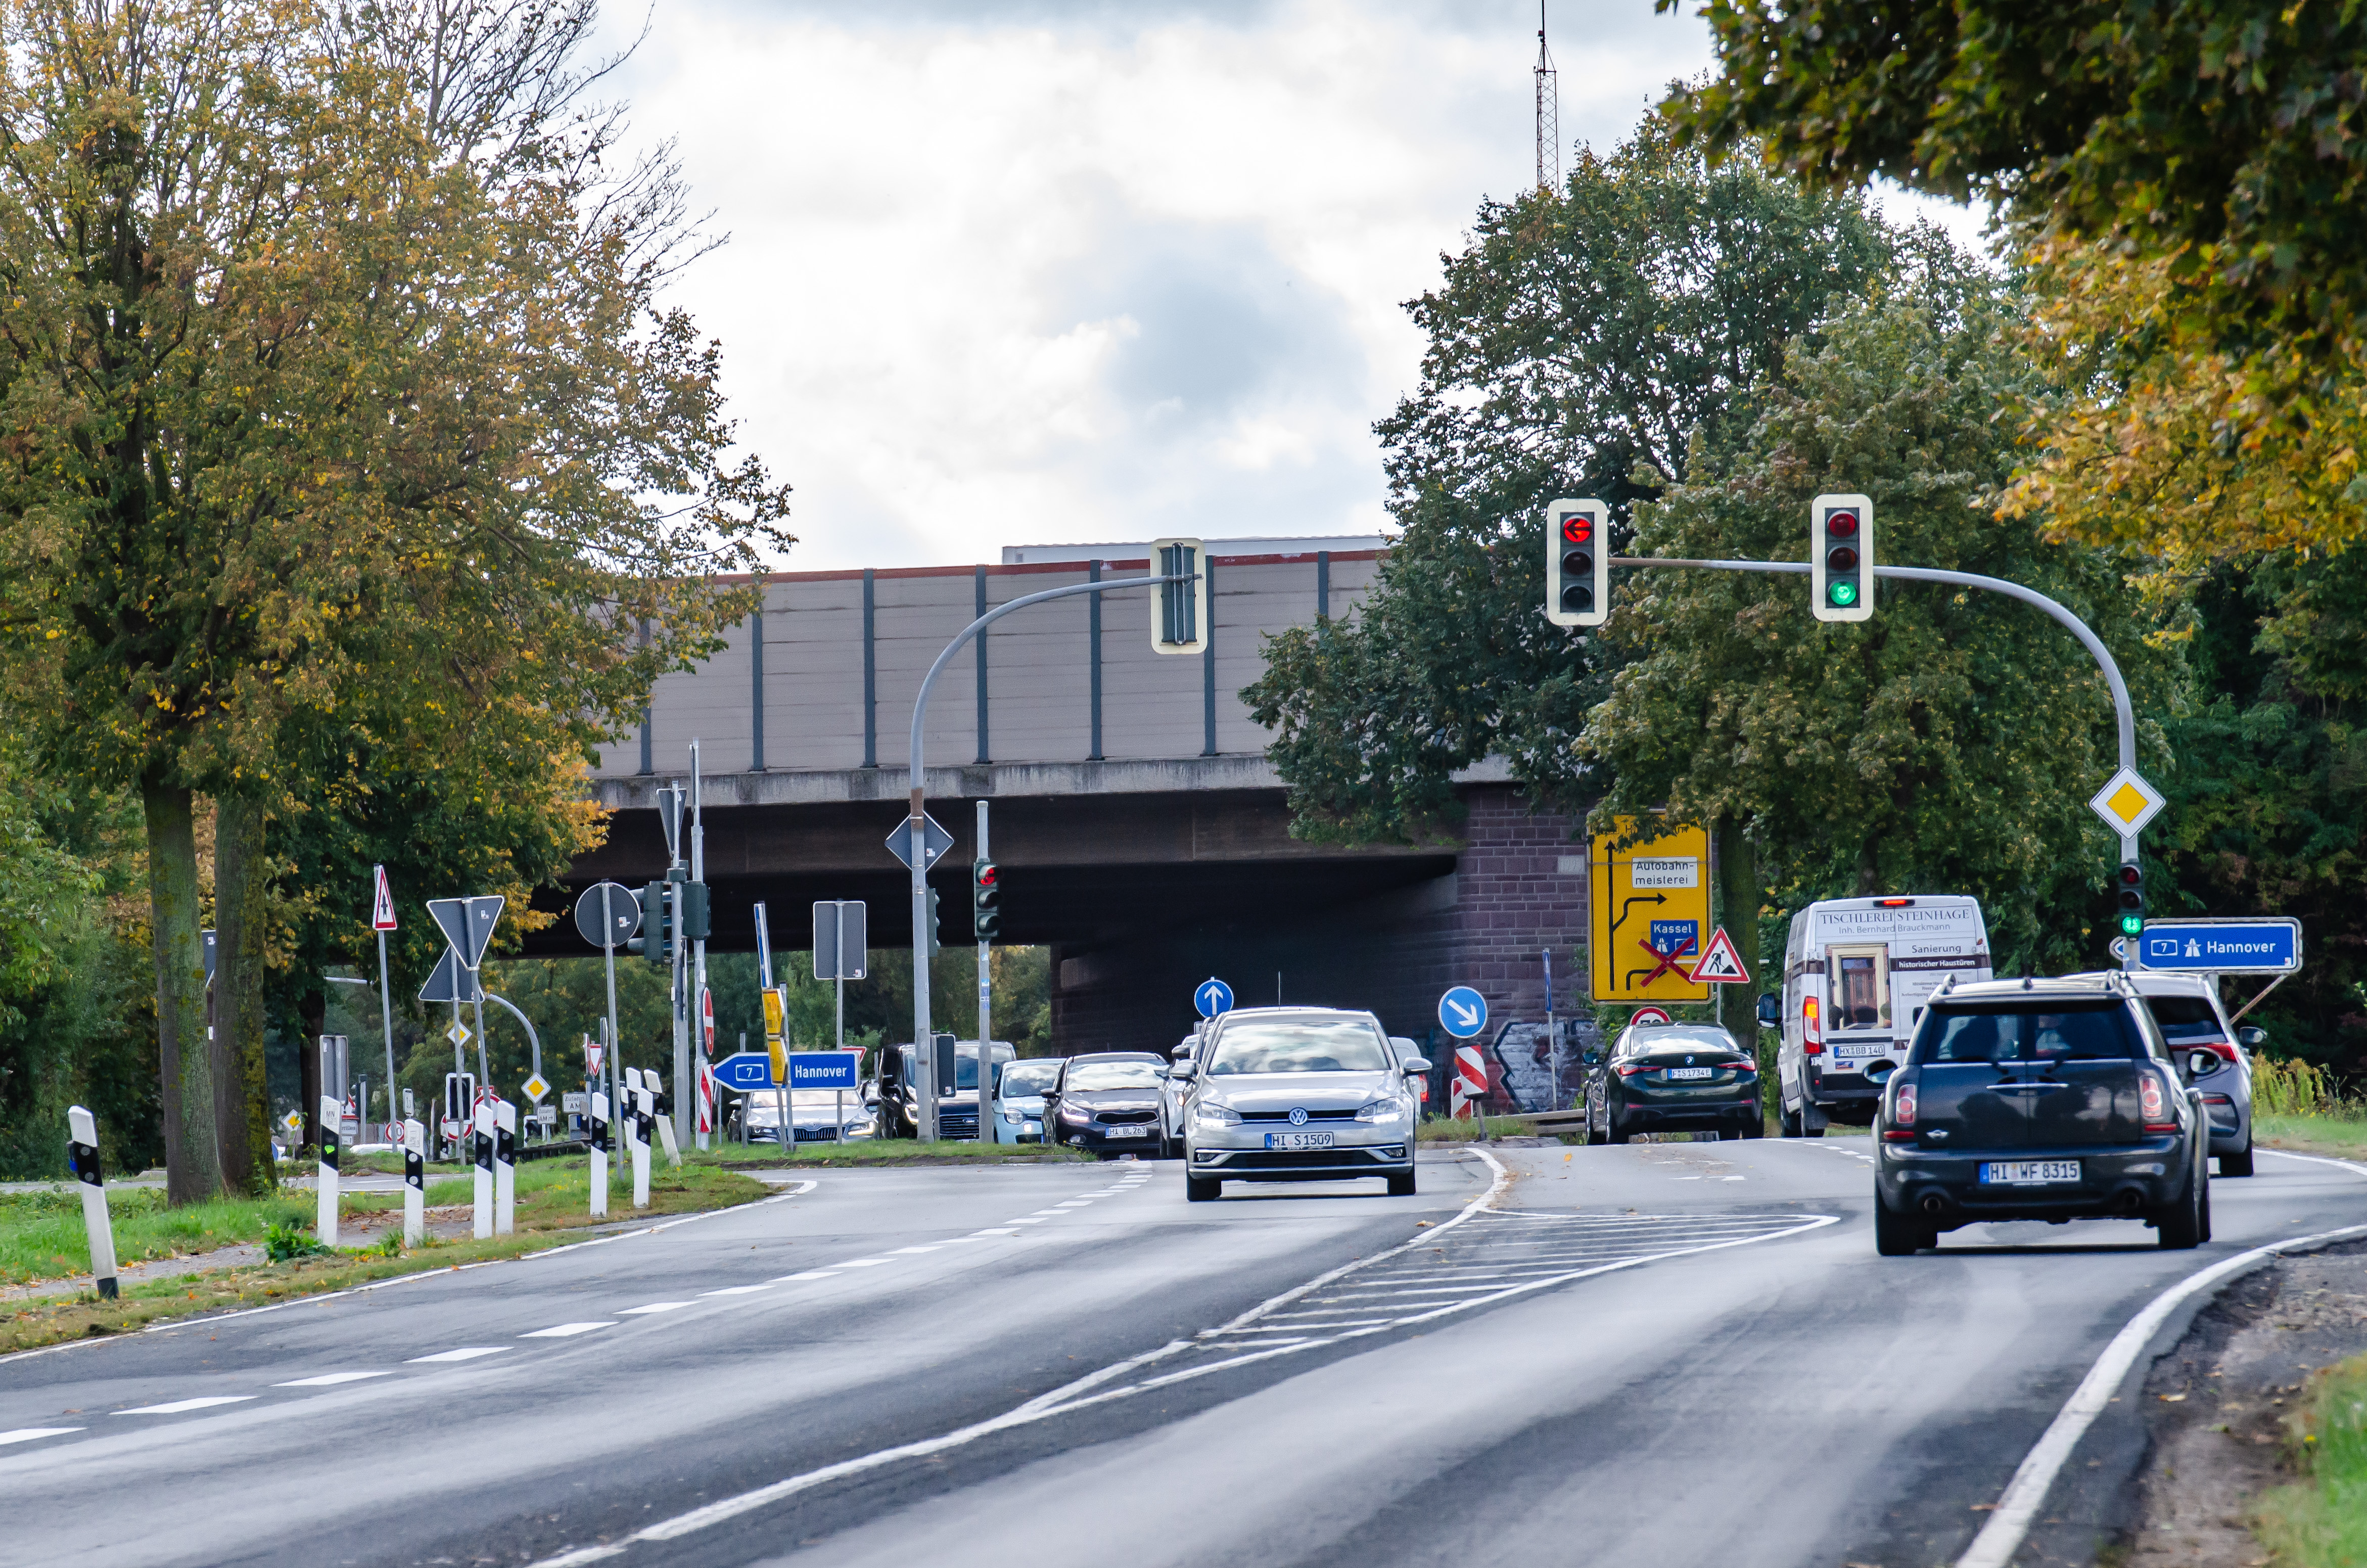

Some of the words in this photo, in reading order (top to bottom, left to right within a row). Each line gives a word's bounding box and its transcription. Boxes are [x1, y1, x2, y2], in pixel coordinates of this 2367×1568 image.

[1636, 861, 1694, 871] Autobahn-
[1636, 874, 1688, 885] meisterei
[1821, 911, 1893, 925] TISCHLEREI
[1897, 909, 1970, 921] STEINHAGE
[1654, 923, 1692, 934] Kassel
[1839, 926, 1854, 934] Inh.
[1857, 924, 1895, 934] Bernhard
[1897, 923, 1951, 932] Brauckmann
[1912, 944, 1962, 955] Sanierung
[2161, 942, 2168, 953] 7
[2207, 940, 2276, 954] Hannover
[1899, 960, 1939, 969] historischer
[1939, 959, 1975, 967] Haustüren
[1840, 1047, 1851, 1055] HX
[1868, 1046, 1883, 1054] 140
[747, 1067, 753, 1078] 7
[795, 1065, 847, 1078] Hannover
[1273, 1135, 1286, 1146] HI
[1990, 1164, 2008, 1180] HI
[2020, 1163, 2037, 1179] WF
[2042, 1162, 2077, 1178] 8315
